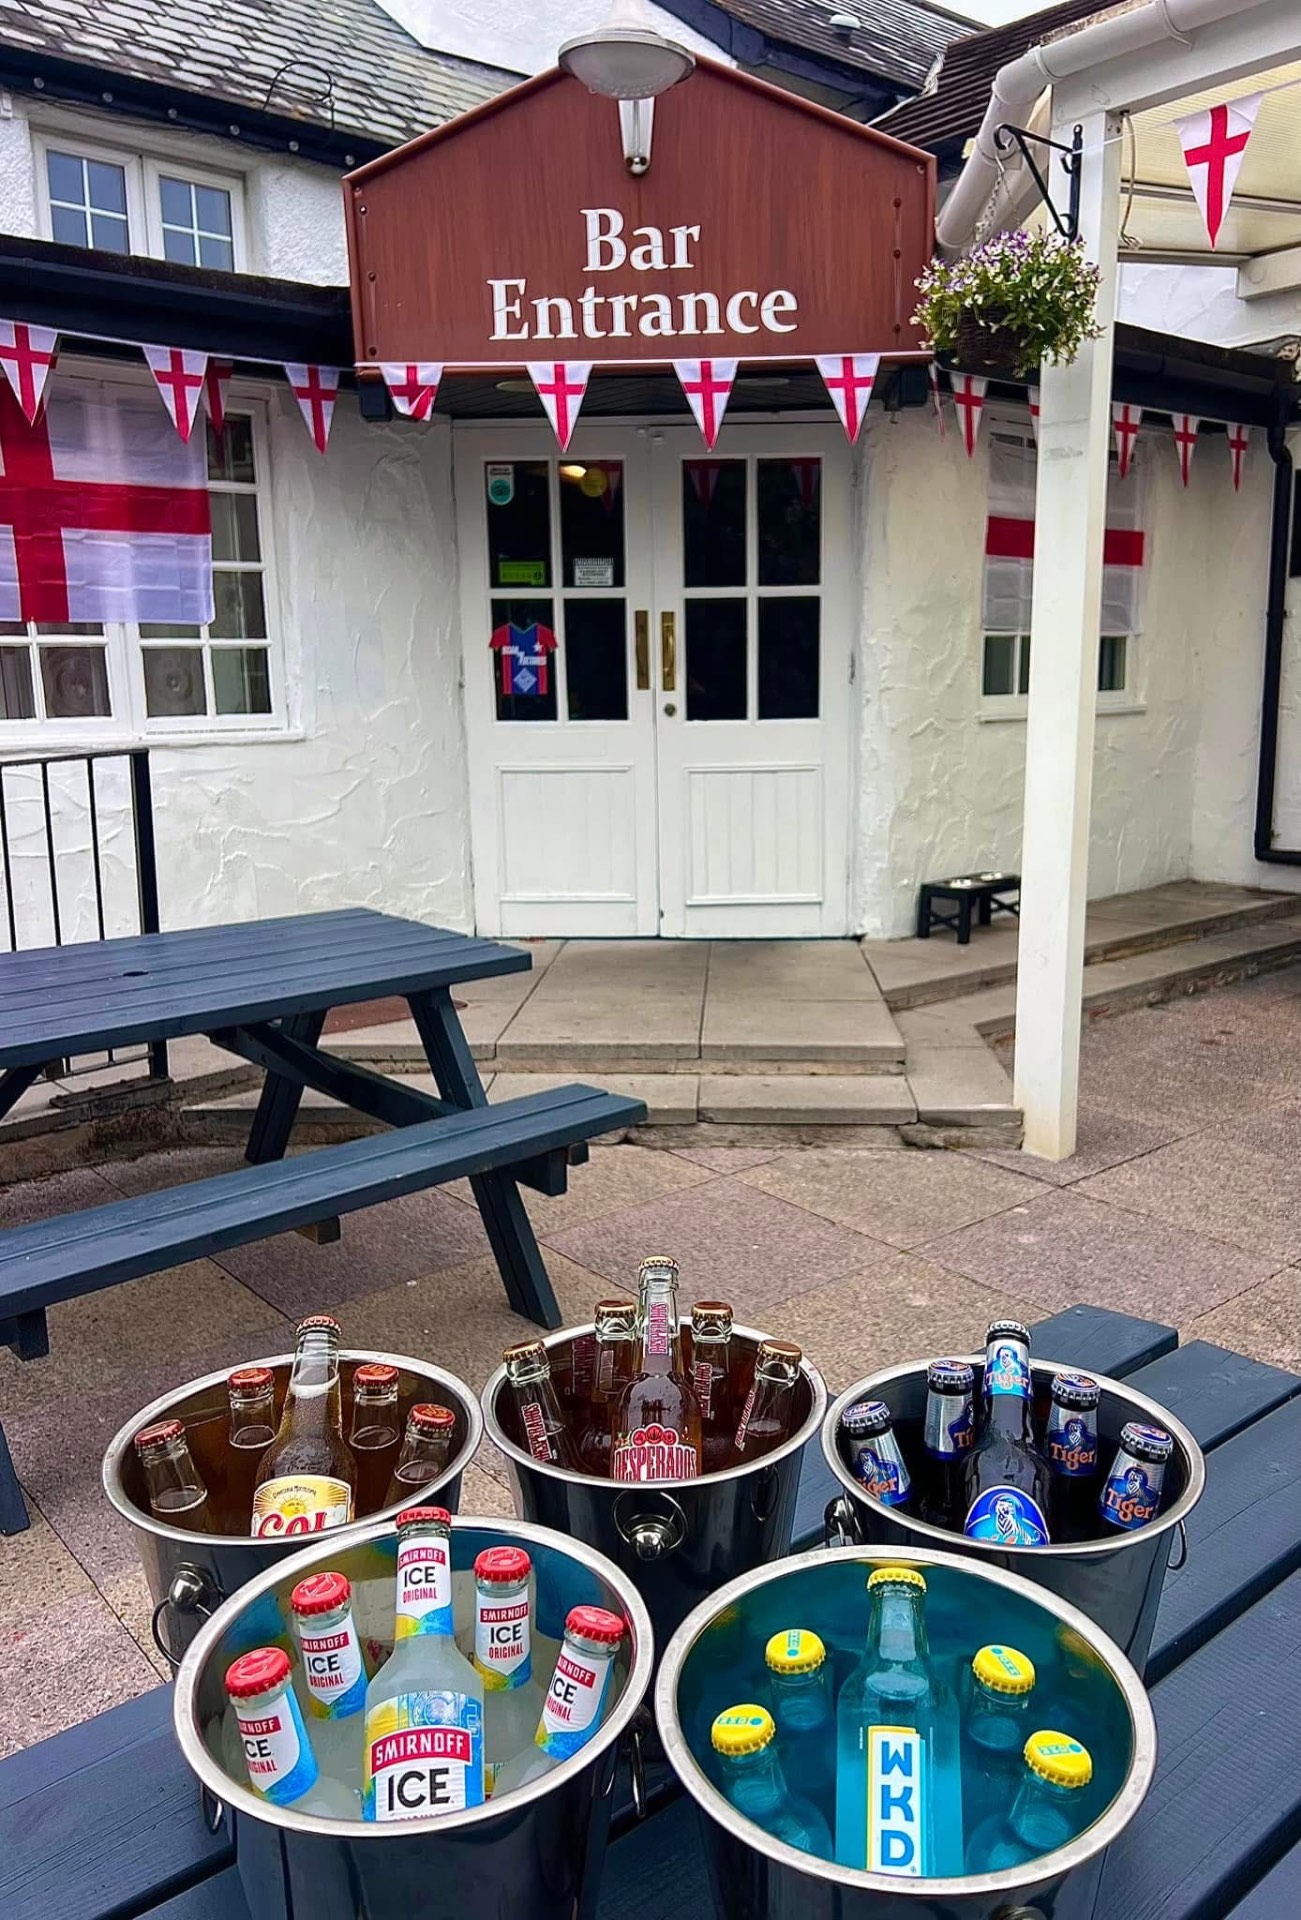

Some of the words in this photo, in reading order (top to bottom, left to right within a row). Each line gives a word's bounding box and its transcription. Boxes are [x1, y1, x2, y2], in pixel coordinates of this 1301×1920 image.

[580, 207, 701, 272] Bar
[486, 278, 798, 341] Entrance
[648, 1302, 668, 1355] DESPERADOS
[986, 1372, 1029, 1390] Tiger
[614, 1444, 697, 1482] DESPERADOS
[1050, 1442, 1094, 1471] Tiger
[857, 1476, 898, 1499] iger
[1106, 1487, 1154, 1523] Tiger
[399, 1549, 444, 1567] SMIRNOFF
[404, 1565, 436, 1587] ICE
[403, 1587, 438, 1604] ORIGINAL
[482, 1605, 528, 1622] SMIRNOFF
[490, 1622, 523, 1644] ICE
[488, 1643, 525, 1660] ORIGINAL
[307, 1653, 340, 1674] ICE
[244, 1738, 272, 1758] CE
[375, 1731, 465, 1767] SMIRNOFF
[387, 1767, 450, 1812] ICE
[880, 1740, 915, 1867] WKD
